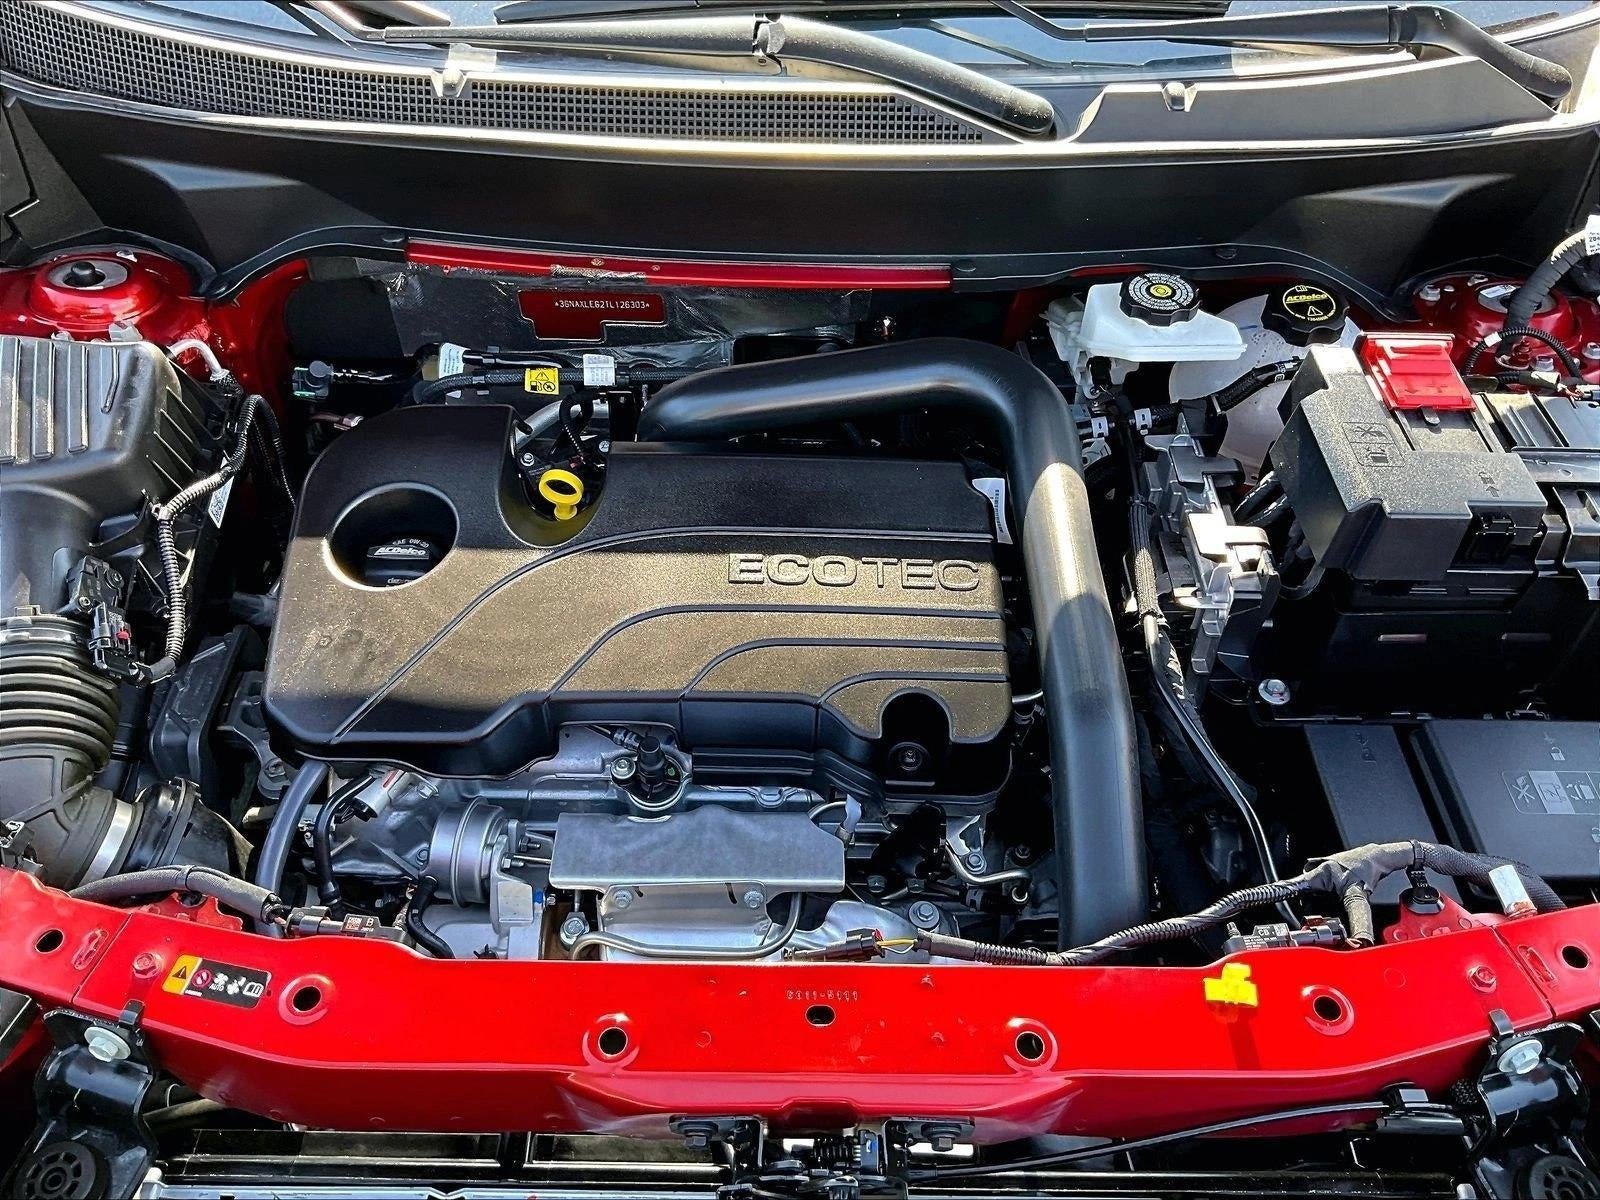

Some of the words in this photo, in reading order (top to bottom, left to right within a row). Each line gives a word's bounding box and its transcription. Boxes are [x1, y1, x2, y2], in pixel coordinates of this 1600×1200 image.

[1285, 294, 1328, 303] ACDelco
[374, 547, 426, 556] ACDelco
[727, 552, 980, 592] ECOTEC
